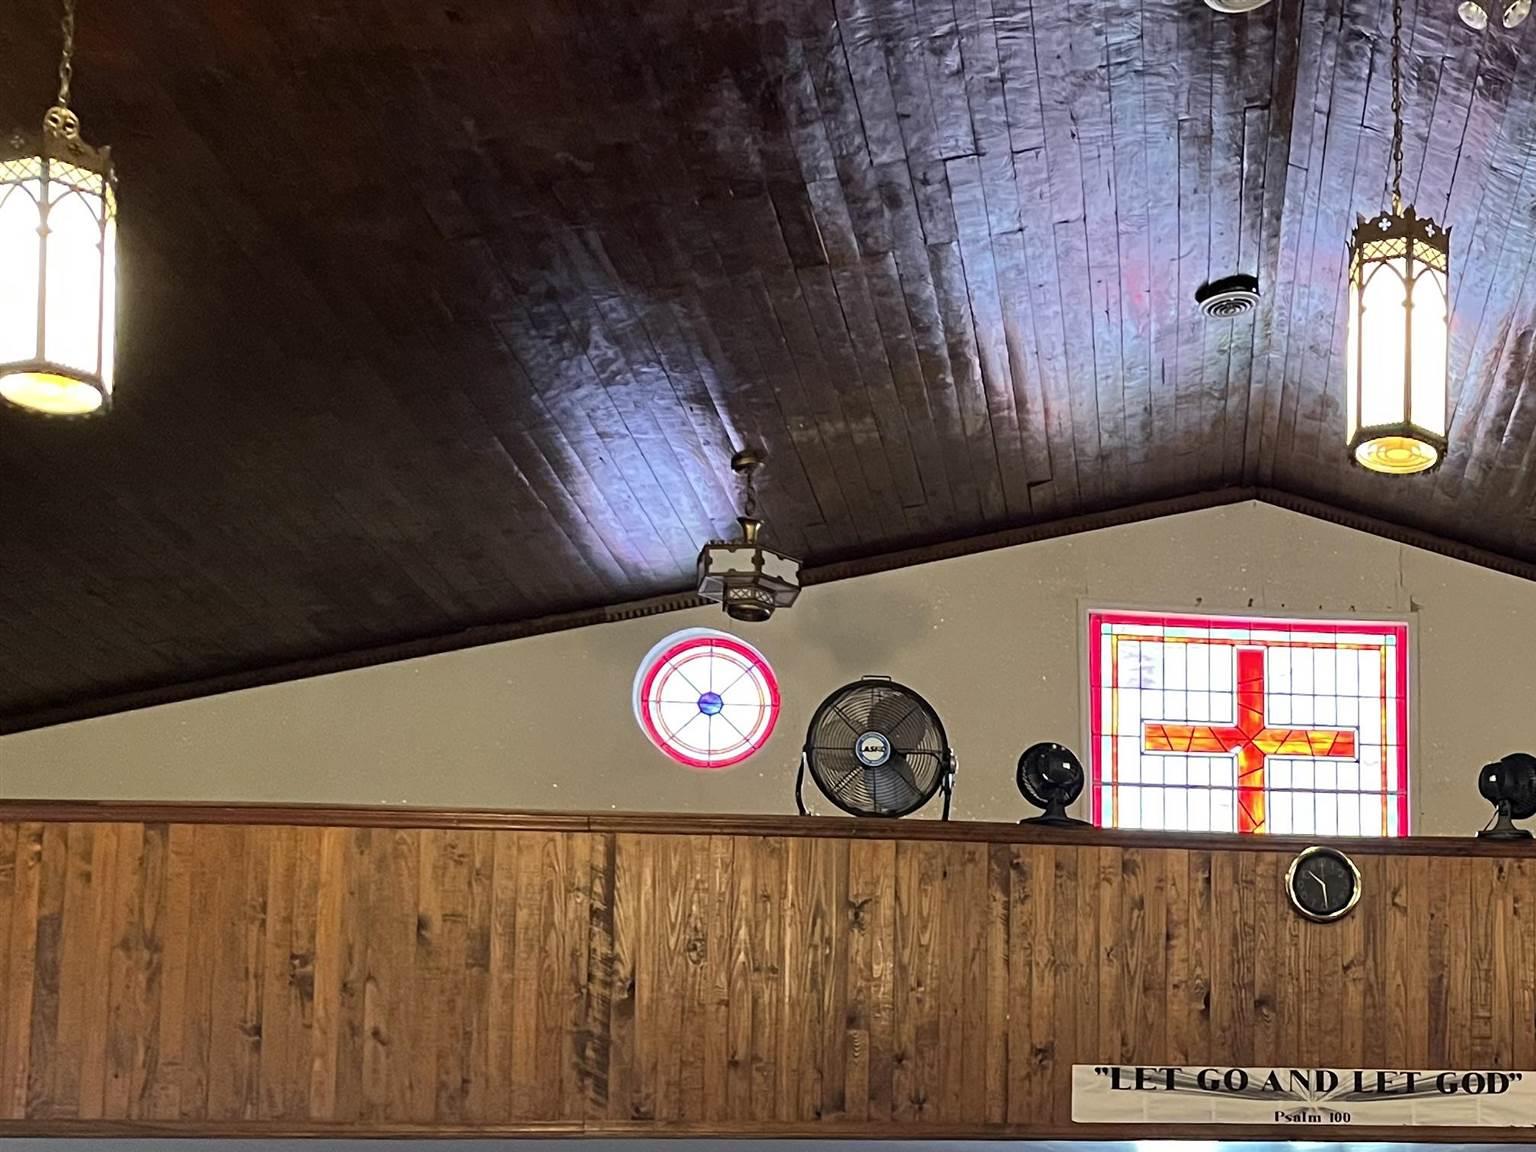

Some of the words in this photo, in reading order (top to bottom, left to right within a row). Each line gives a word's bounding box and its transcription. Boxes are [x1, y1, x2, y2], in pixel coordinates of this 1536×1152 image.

[1197, 1068, 1249, 1092] GO
[1262, 1069, 1339, 1093] AND
[1353, 1070, 1421, 1094] LET
[1274, 1111, 1321, 1123] Psalm
[1329, 1112, 1351, 1123] 100
